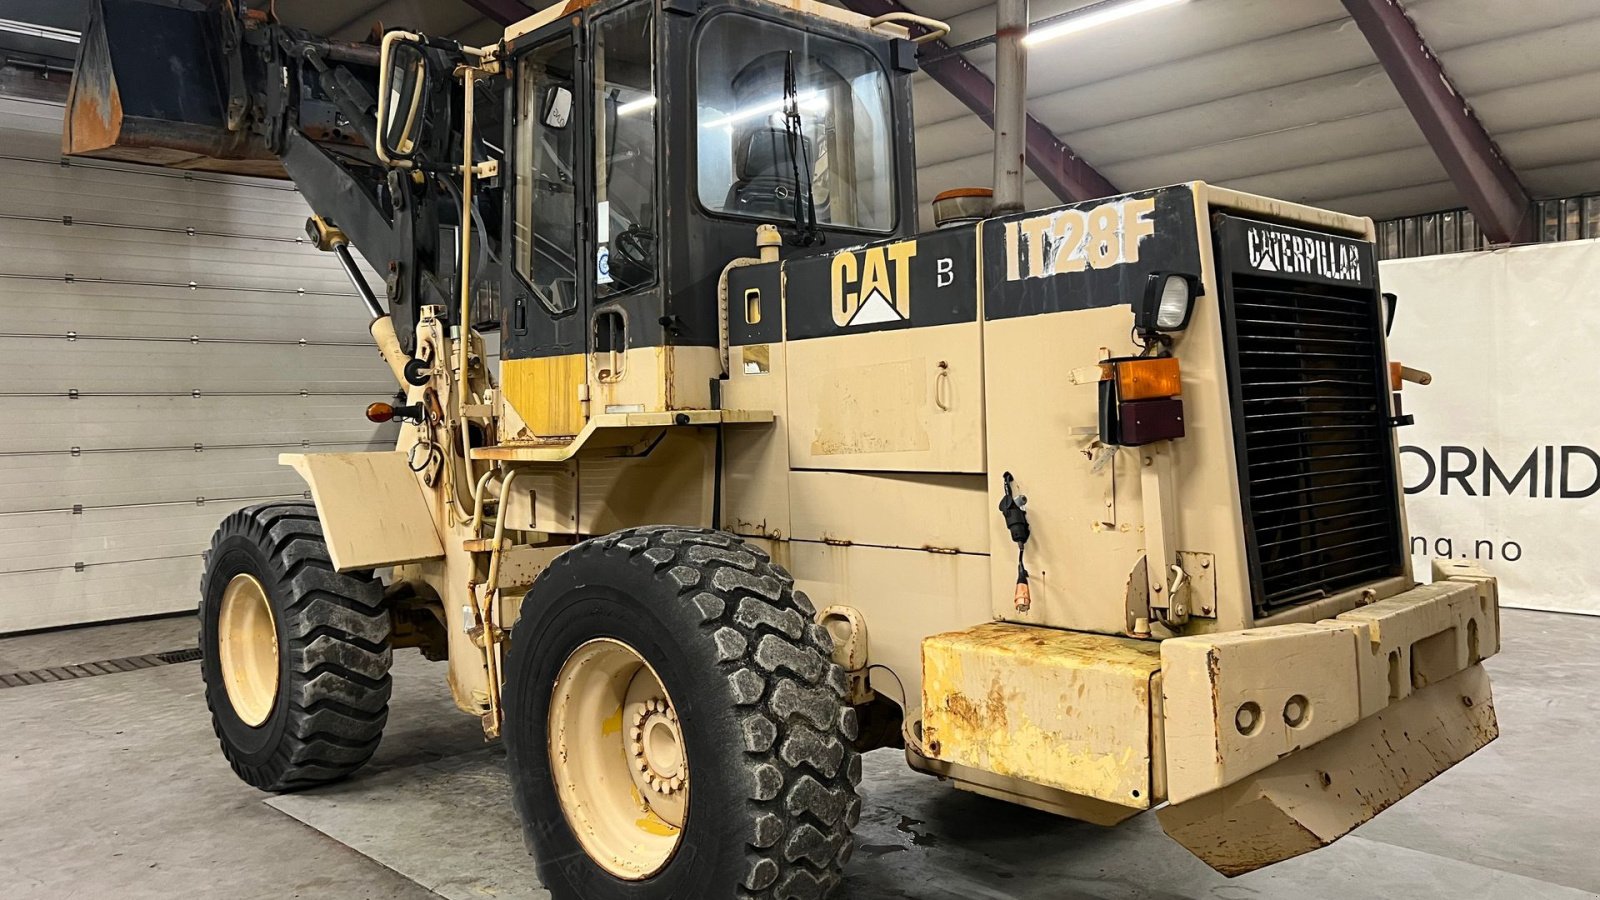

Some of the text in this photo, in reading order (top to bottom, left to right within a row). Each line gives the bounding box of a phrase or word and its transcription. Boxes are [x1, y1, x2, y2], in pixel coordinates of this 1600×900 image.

[937, 258, 954, 287] B
[1004, 198, 1155, 281] IT28F
[1247, 227, 1360, 281] CATERPILLAR
[831, 240, 917, 327] CAT
